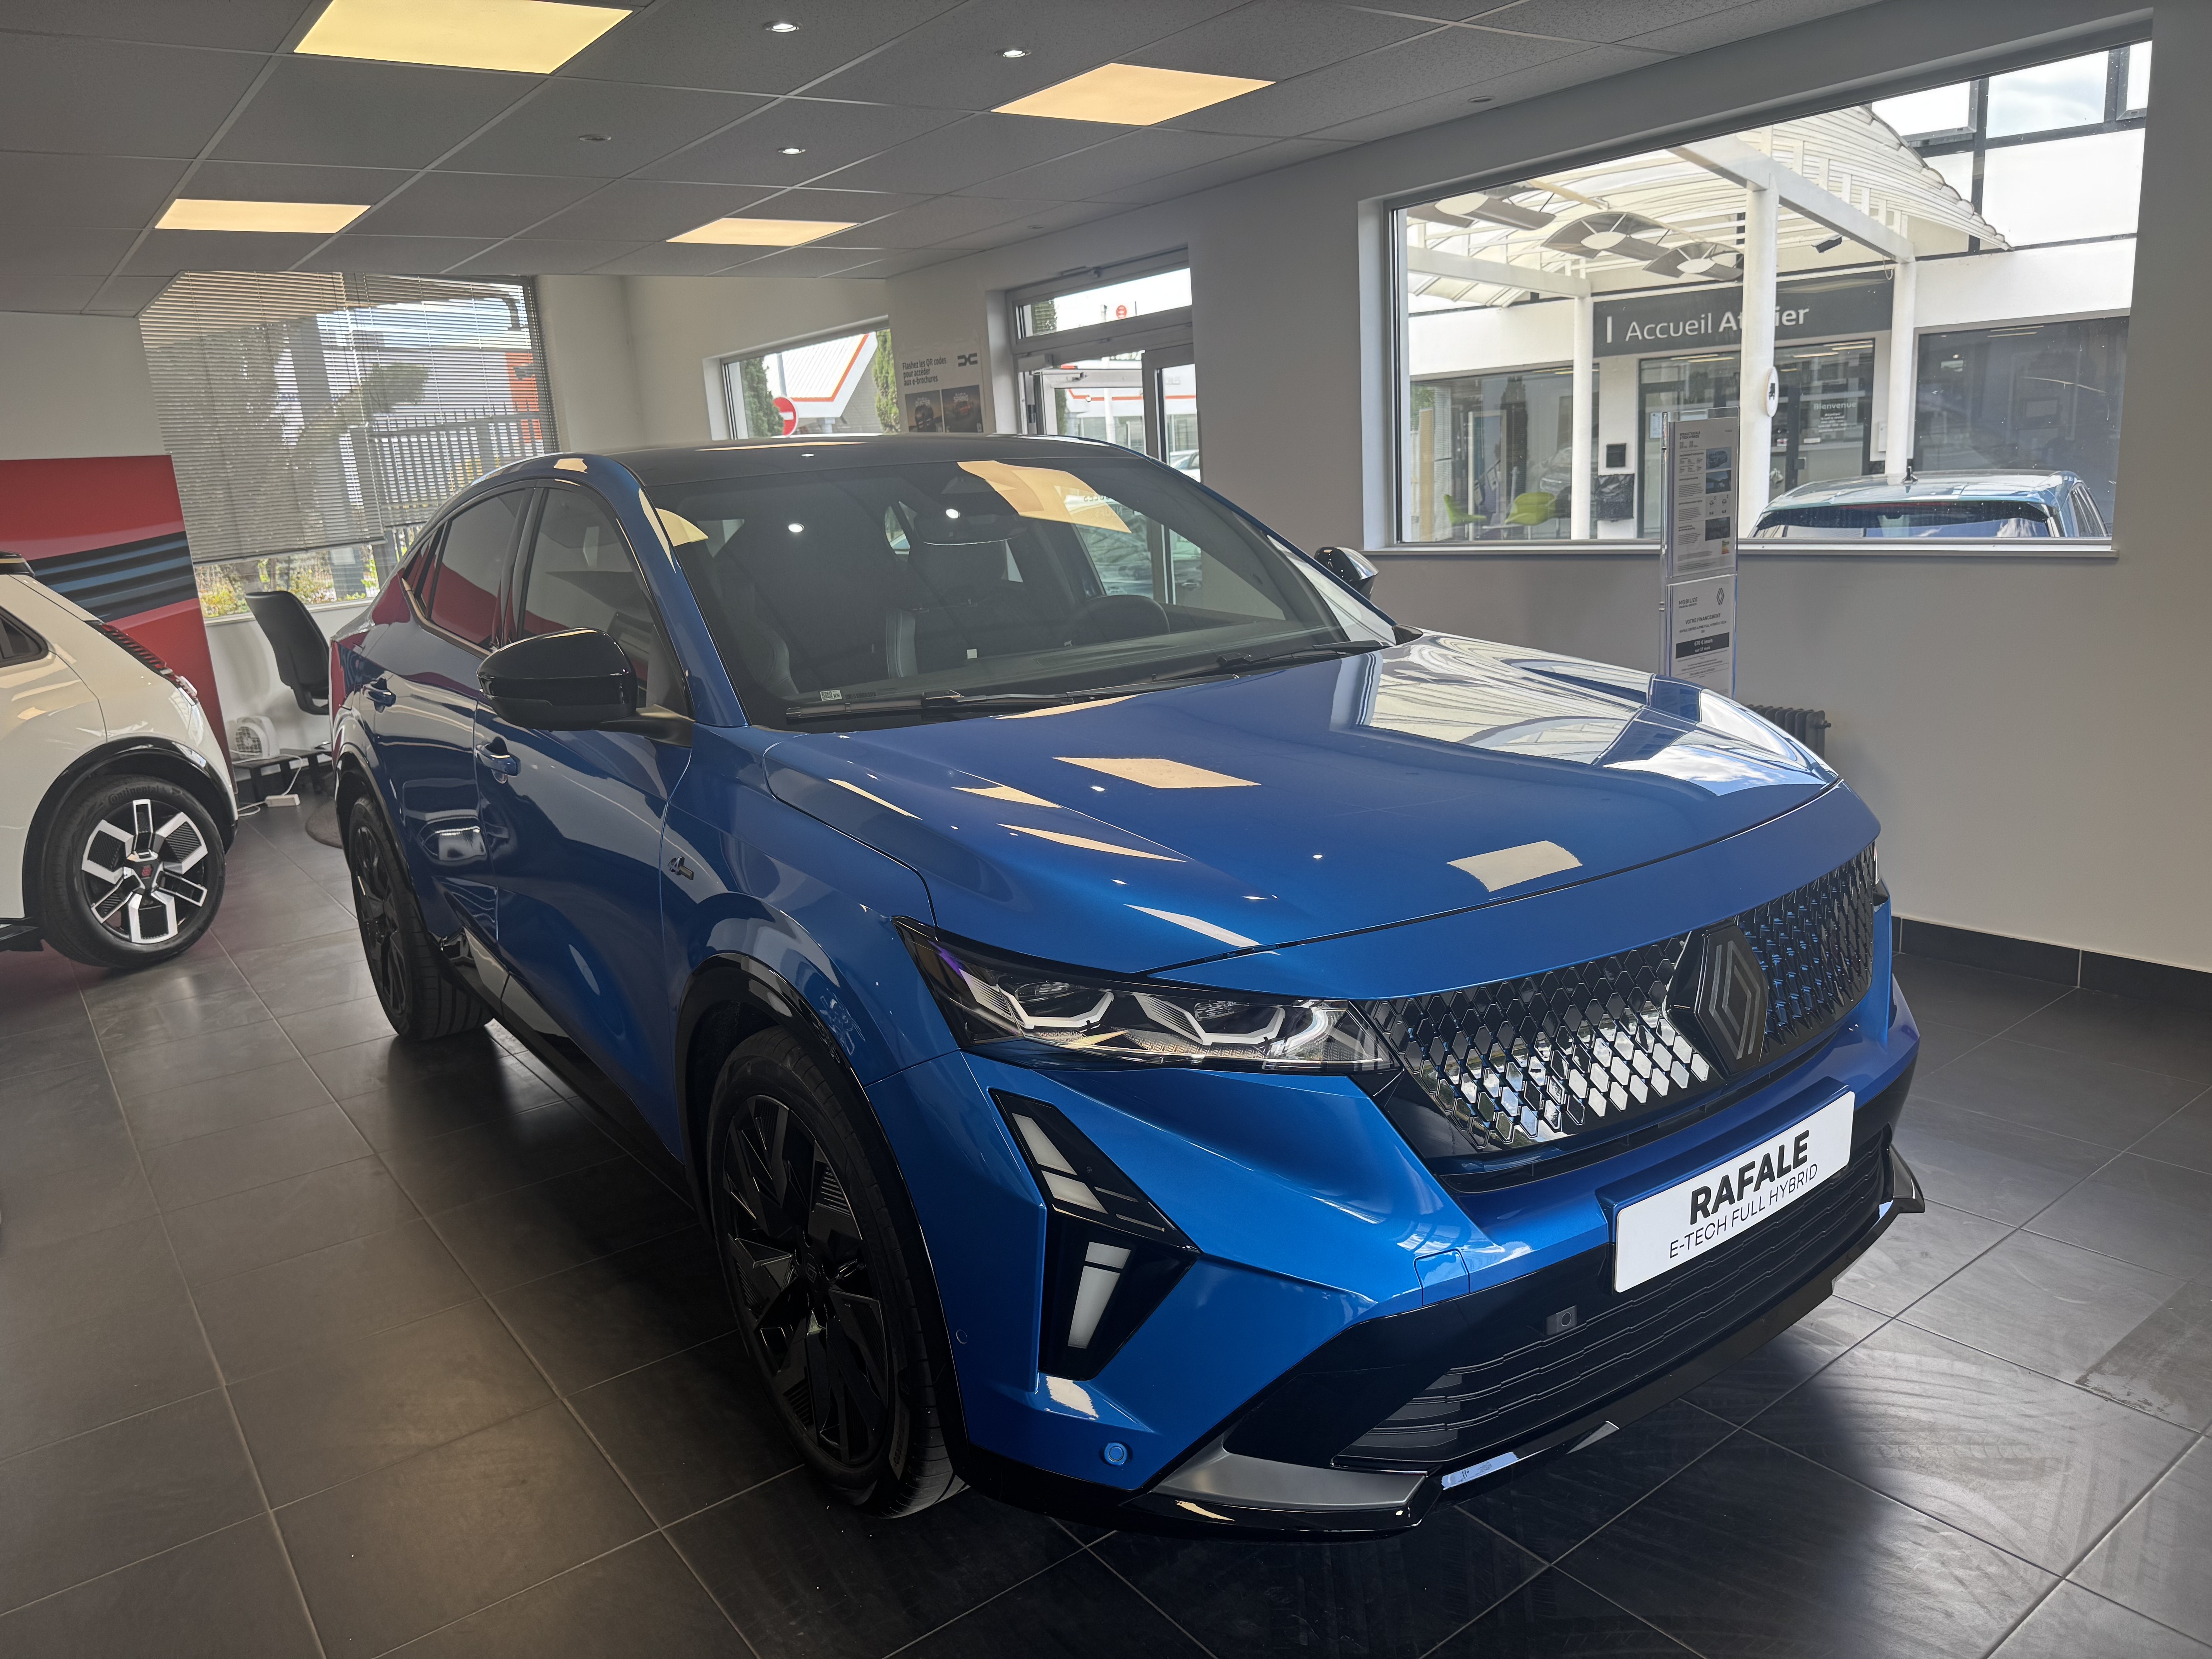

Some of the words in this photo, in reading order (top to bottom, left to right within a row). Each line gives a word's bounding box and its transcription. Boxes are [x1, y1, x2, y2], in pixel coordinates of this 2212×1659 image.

[1625, 313, 1712, 341] Accueil
[1718, 306, 1810, 333] Atier
[902, 361, 918, 370] Flashez
[926, 359, 933, 367] QR
[934, 357, 946, 365] codes
[903, 371, 913, 380] pour
[912, 376, 938, 385] e-brochures
[1813, 402, 1857, 410] Bienvenue
[1679, 597, 1698, 605] MOBILIZE
[1697, 613, 1721, 622] FINANCEMENT
[108, 786, 159, 803] Continental
[1690, 1130, 1809, 1225] RAFALE
[1669, 1214, 1727, 1259] E-TECH
[1732, 1196, 1766, 1228] FULL
[1769, 1163, 1817, 1206] HYBRID
